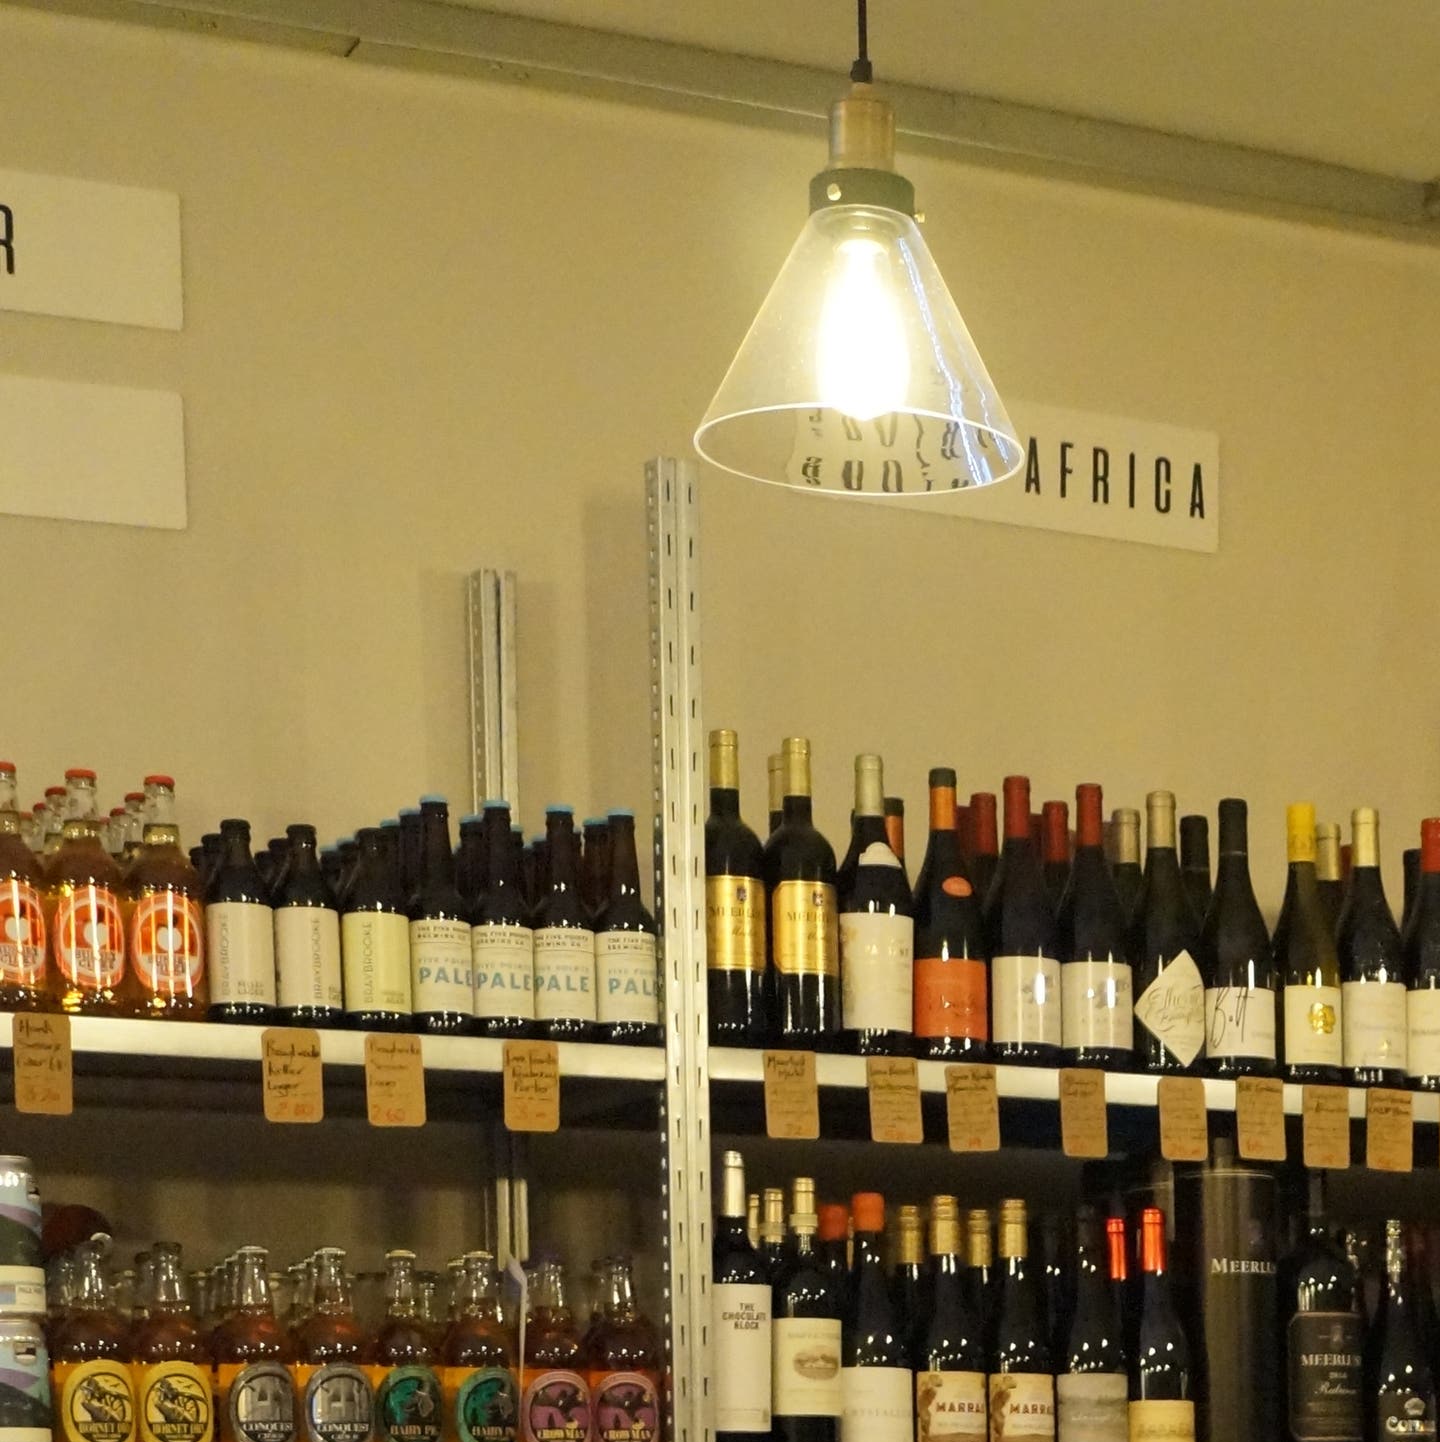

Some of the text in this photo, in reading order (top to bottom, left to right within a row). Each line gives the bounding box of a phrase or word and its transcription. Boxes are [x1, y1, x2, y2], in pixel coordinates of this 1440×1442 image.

[1023, 436, 1207, 519] AFRICA
[362, 922, 373, 1004] BRAYBROOKE
[476, 971, 532, 991] PALE
[534, 974, 590, 993] PALE
[739, 1302, 755, 1312] THE
[734, 1320, 760, 1330] BLOCK
[243, 1421, 294, 1433] CONQUEST
[316, 1423, 369, 1434] CONQUEST
